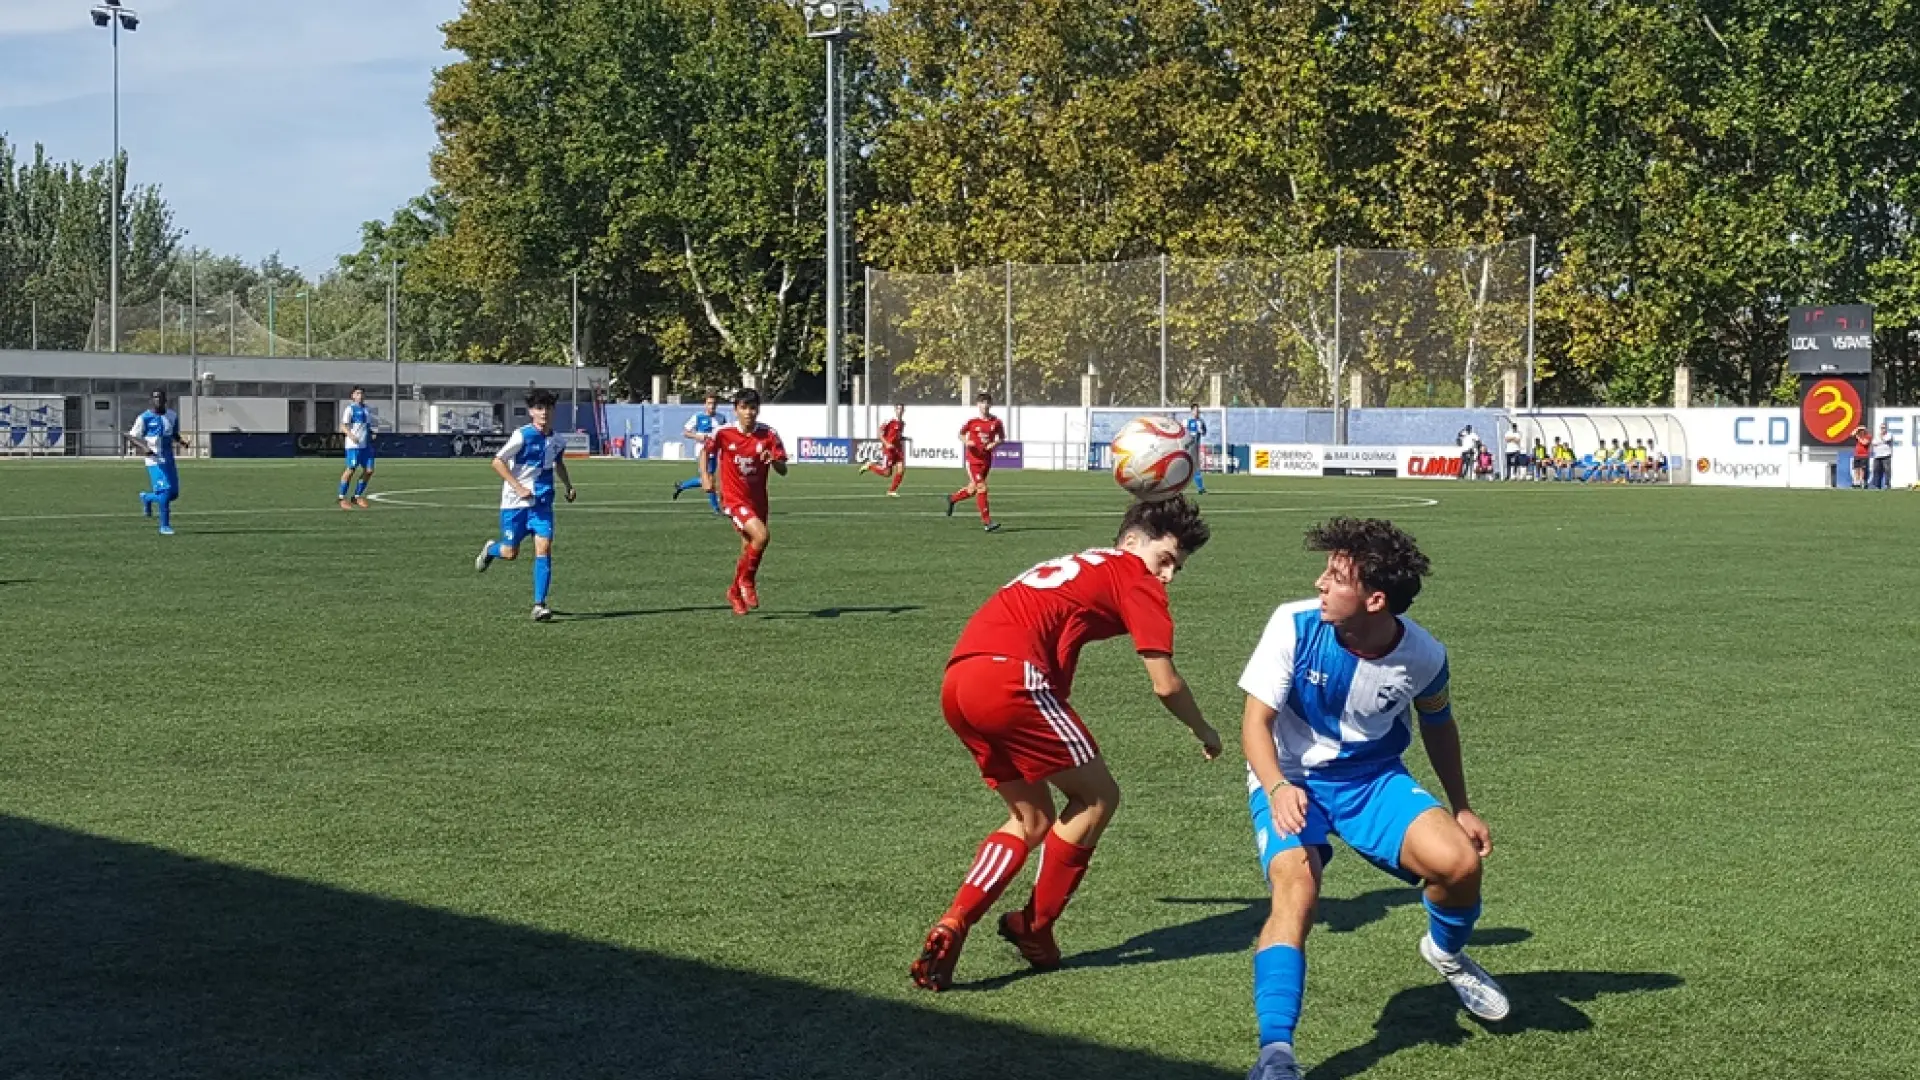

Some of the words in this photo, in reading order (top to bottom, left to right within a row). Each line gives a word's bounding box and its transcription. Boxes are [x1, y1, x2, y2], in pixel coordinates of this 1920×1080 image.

[1791, 337, 1820, 350] LOCAL
[1832, 335, 1873, 350] VISITANTE
[800, 440, 848, 458] Rótulos
[1269, 450, 1314, 460] GOBIERNO
[1334, 451, 1349, 461] BAR
[1352, 451, 1361, 461] LA
[1269, 461, 1281, 470] DE
[1713, 457, 1782, 479] bopepor
